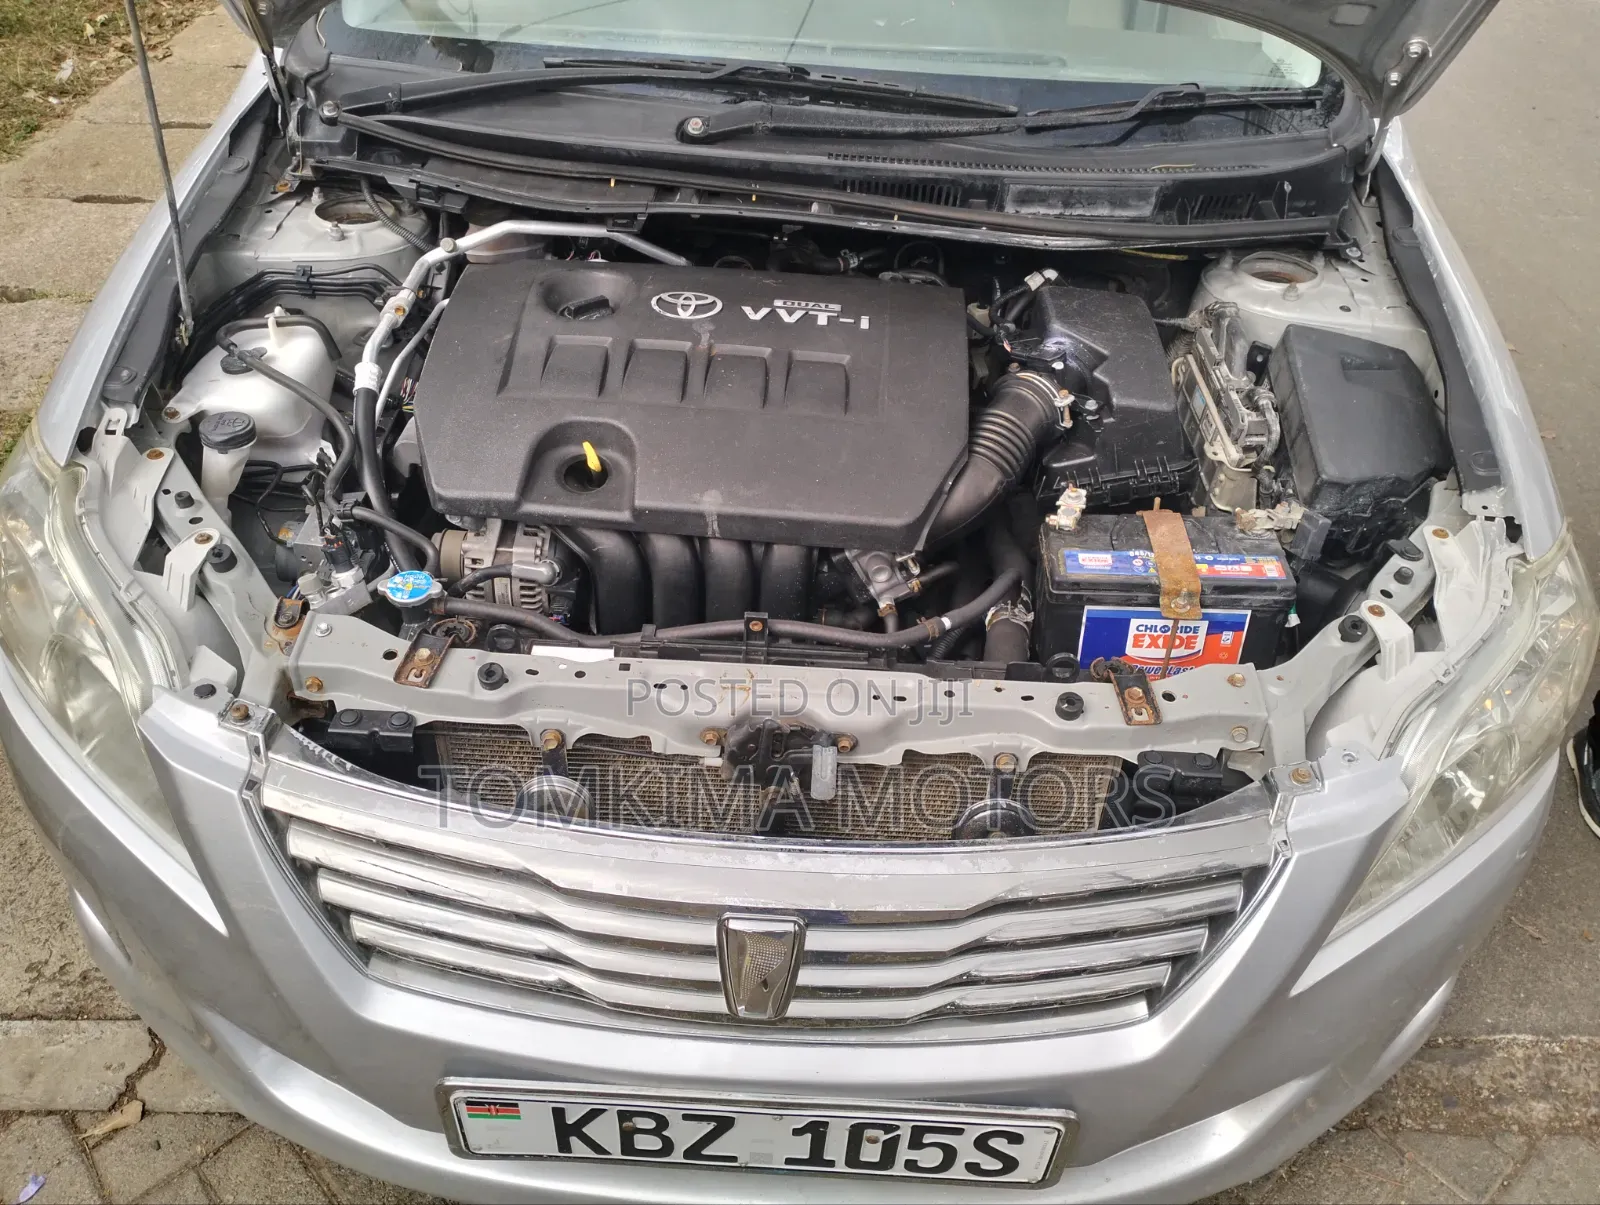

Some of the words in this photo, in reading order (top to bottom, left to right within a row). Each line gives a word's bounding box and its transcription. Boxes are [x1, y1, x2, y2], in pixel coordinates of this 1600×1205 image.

[782, 300, 836, 309] DUAL
[1132, 633, 1199, 650] EXIDE
[551, 1107, 738, 1163] KBZ
[784, 1120, 1024, 1178] 105S
